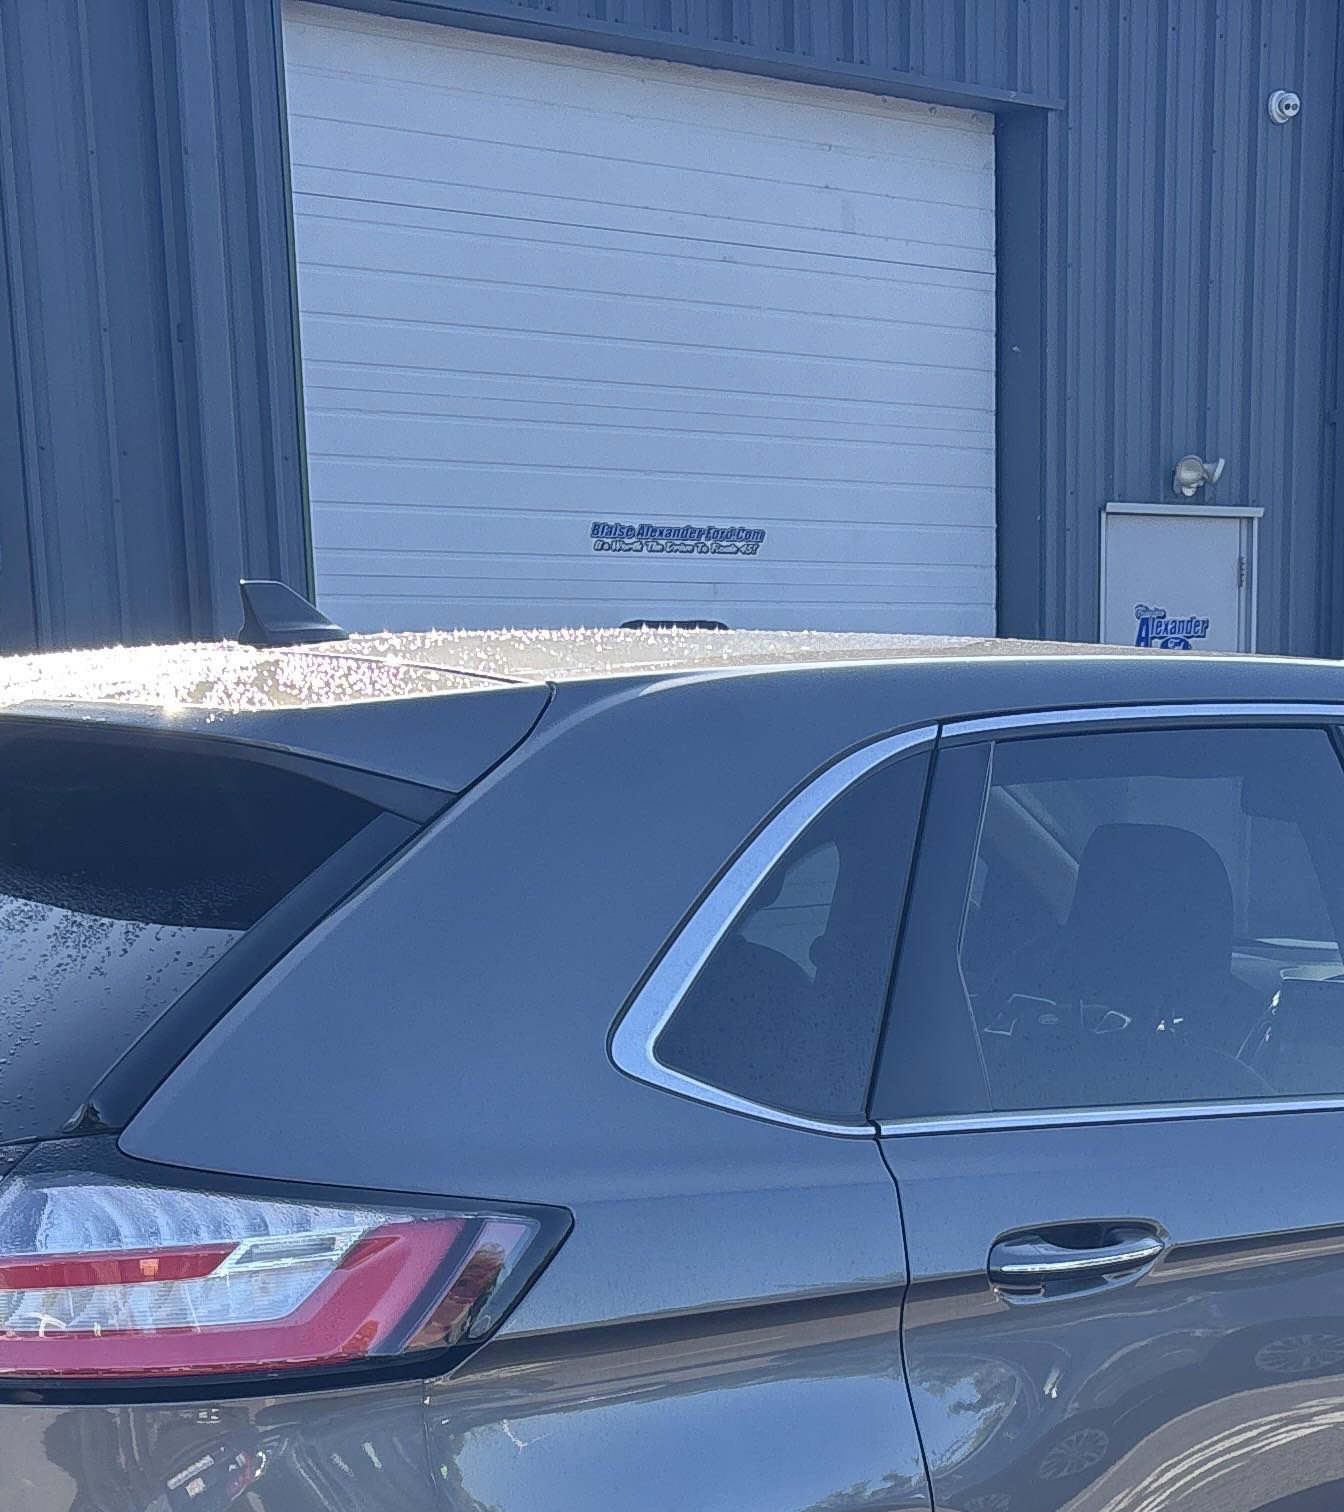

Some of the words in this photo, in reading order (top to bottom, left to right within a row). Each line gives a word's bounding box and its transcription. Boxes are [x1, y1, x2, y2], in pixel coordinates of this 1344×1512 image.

[591, 522, 635, 539] Blaise
[637, 524, 704, 541] Alexander
[1136, 617, 1208, 648] Alexander
